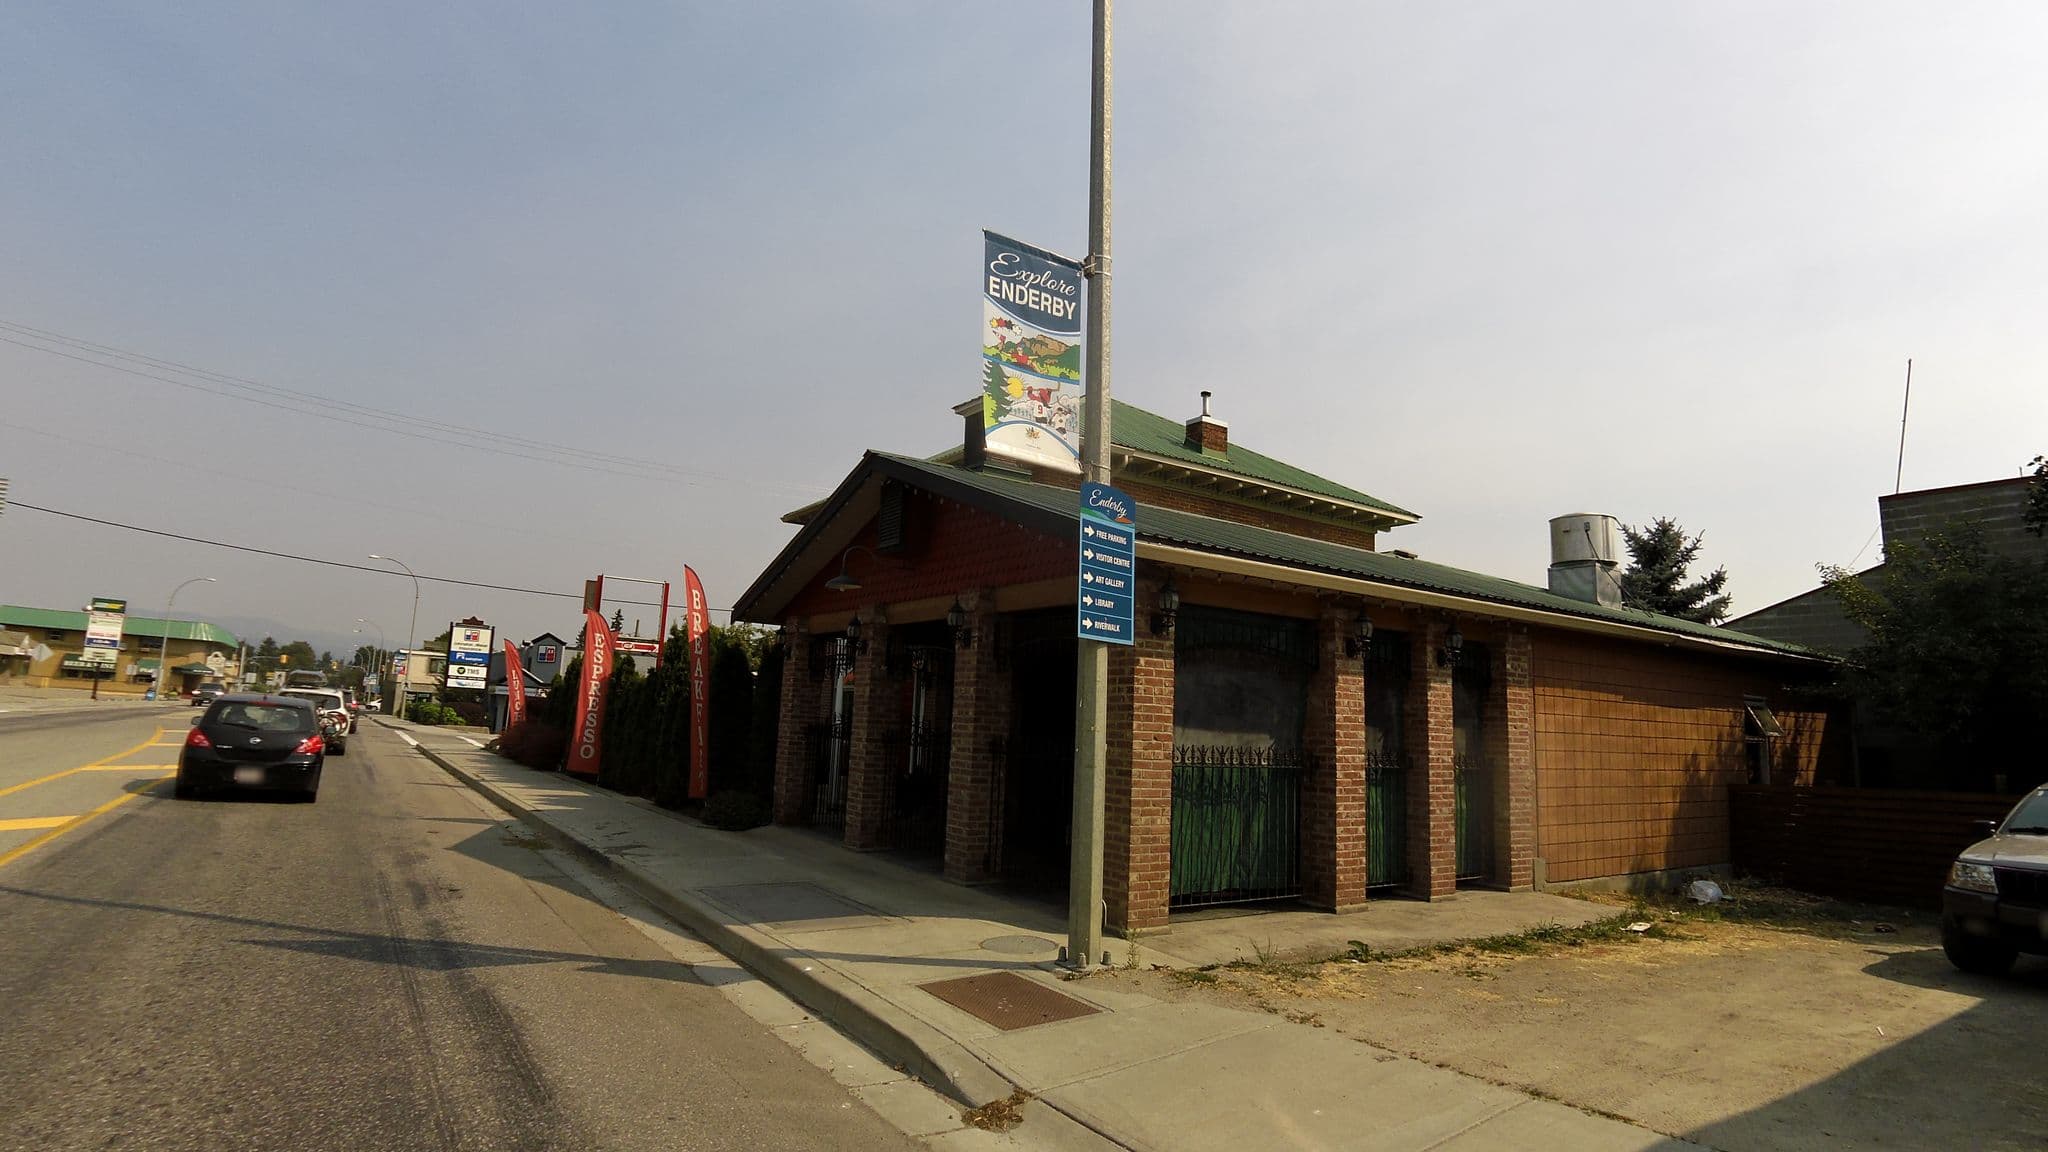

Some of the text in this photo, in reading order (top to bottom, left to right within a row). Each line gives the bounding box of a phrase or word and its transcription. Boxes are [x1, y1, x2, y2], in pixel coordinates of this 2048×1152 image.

[990, 252, 1076, 296] Explore
[989, 275, 1076, 320] ENDERBY
[1089, 489, 1127, 519] Enderby
[1096, 529, 1127, 545] FREE PARKING
[1095, 552, 1131, 568] VISITOR CENTRE
[1095, 575, 1124, 589] ART GALLERY
[1094, 598, 1114, 609] LIBRARY
[1094, 620, 1120, 632] RIVERWALK
[579, 632, 605, 760] ESPRESSO
